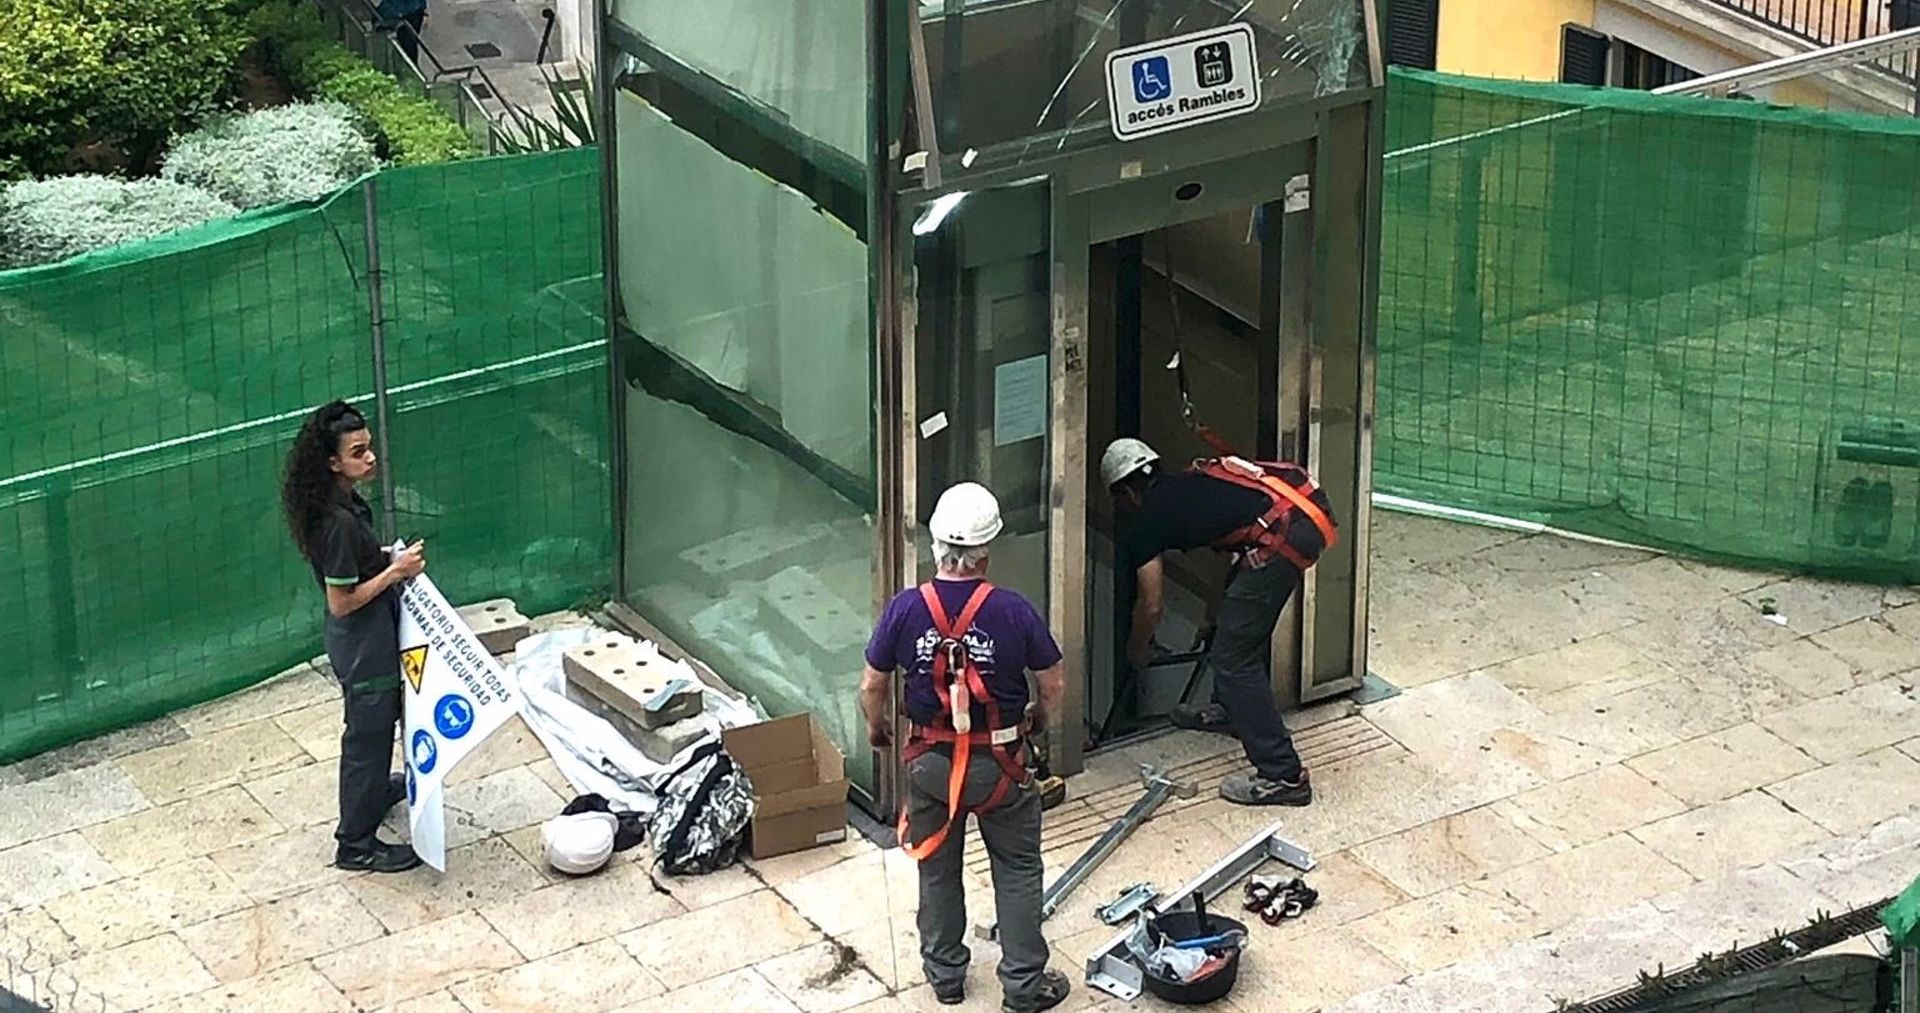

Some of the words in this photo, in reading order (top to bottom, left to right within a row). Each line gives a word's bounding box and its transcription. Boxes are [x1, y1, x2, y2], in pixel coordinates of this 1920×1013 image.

[1127, 103, 1175, 124] accés
[1178, 87, 1246, 113] Rambles
[403, 594, 434, 637] NORMAS
[431, 635, 447, 652] DE
[442, 650, 492, 707] SEGURIDAD
[451, 633, 485, 672] SEGUIR
[481, 669, 512, 703] TODAS
